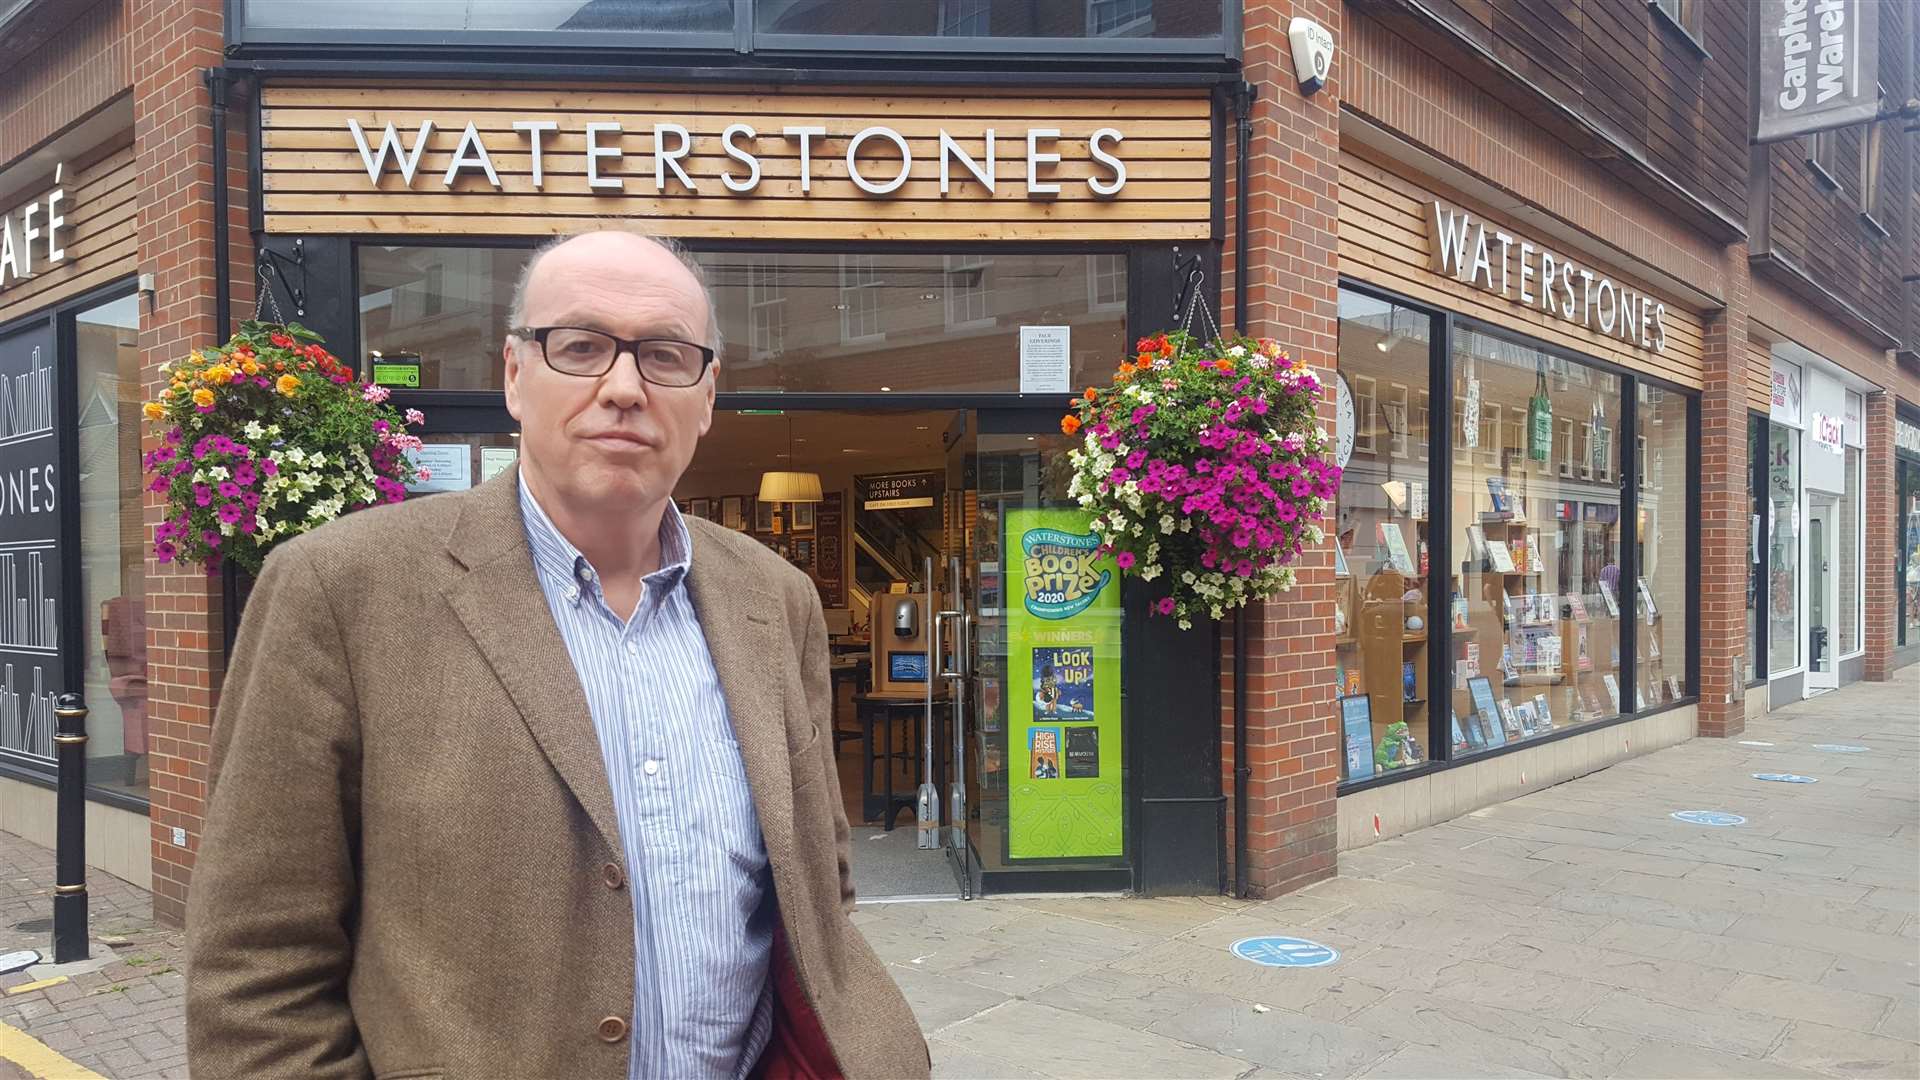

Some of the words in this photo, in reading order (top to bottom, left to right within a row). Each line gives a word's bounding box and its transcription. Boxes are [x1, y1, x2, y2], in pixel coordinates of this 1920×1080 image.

[346, 117, 1128, 203] WATERSTONES
[1430, 200, 1667, 353] WATERSTONES
[0, 464, 55, 516] NES
[870, 481, 889, 490] MORE
[891, 479, 917, 489] BOOKS
[869, 488, 900, 499] UPSTAIRS
[1024, 549, 1101, 582] BOOK
[1037, 592, 1065, 604] 2020
[1033, 631, 1094, 642] WINNERS
[1053, 651, 1091, 668] LOOK
[1035, 731, 1056, 740] HIGH
[1035, 740, 1056, 749] RISE
